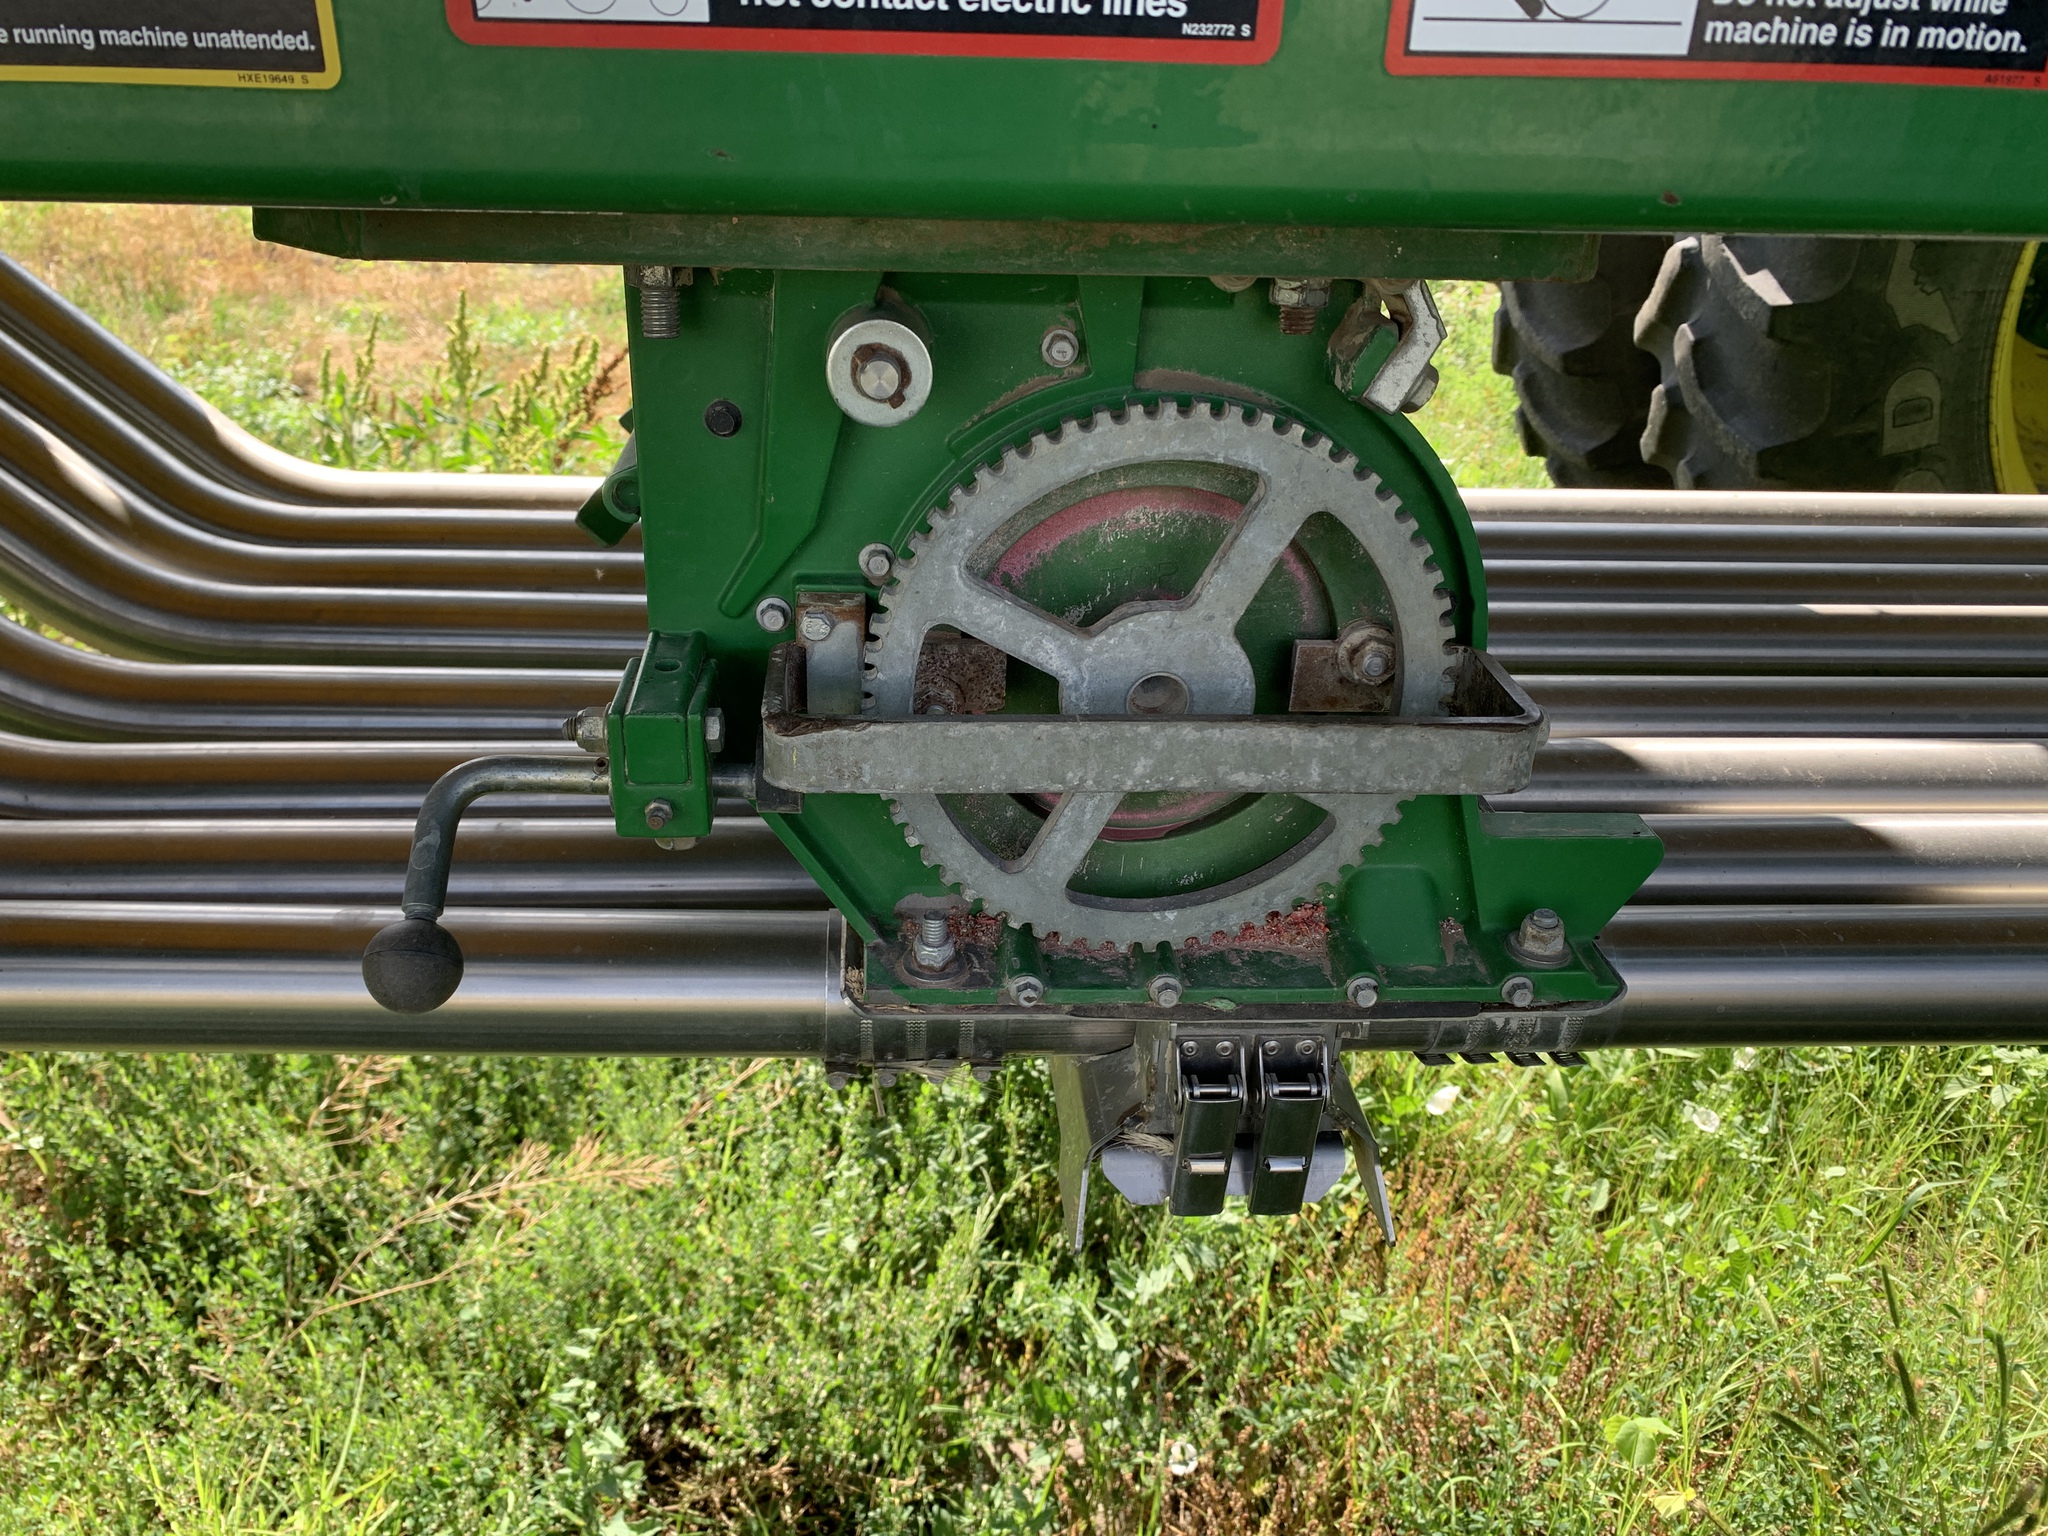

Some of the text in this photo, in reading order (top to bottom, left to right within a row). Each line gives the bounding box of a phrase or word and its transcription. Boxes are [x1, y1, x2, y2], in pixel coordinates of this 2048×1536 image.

[12, 24, 95, 50] running
[98, 26, 189, 47] machine
[192, 29, 316, 51] unattended.
[1182, 22, 1251, 37] N232772 S
[1704, 15, 2027, 53] machine is in motion.
[237, 73, 309, 84] HXE19649 S
